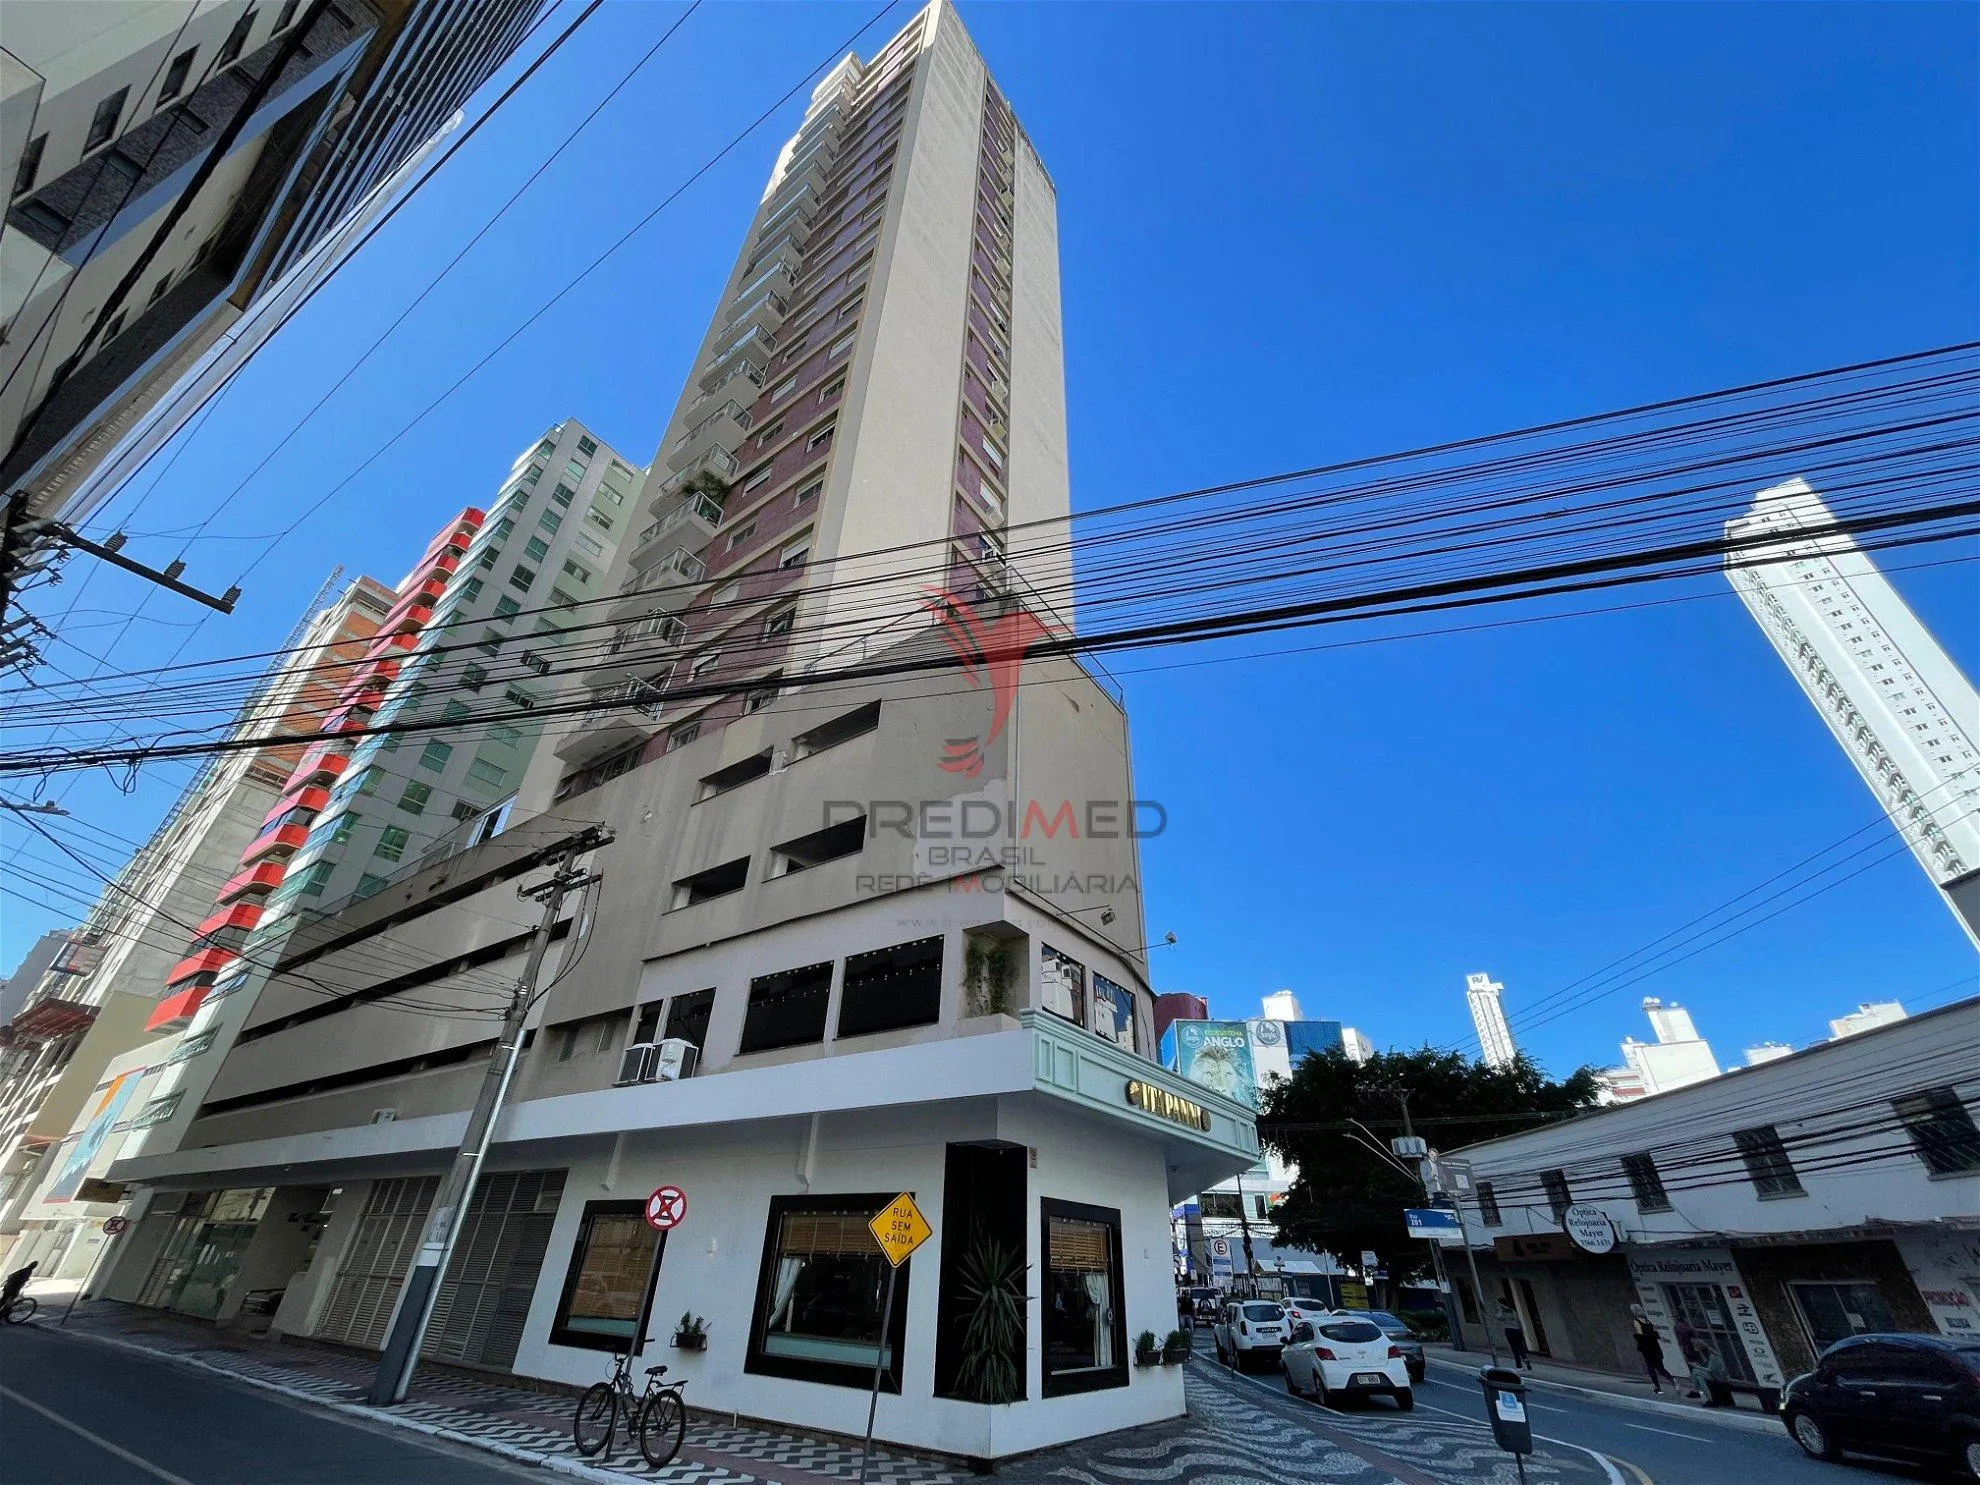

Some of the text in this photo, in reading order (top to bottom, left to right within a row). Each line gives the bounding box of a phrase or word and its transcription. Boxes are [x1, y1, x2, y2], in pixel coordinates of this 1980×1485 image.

[1202, 1036, 1245, 1048] ANGLO
[892, 1207, 912, 1219] RUA
[891, 1220, 911, 1232] SEM
[1568, 1218, 1607, 1228] Relojoaria
[884, 1232, 914, 1245] SAÍDA
[1579, 1229, 1603, 1238] Mayer
[1657, 1260, 1702, 1275] Relojoaria
[1700, 1259, 1734, 1276] Mayer
